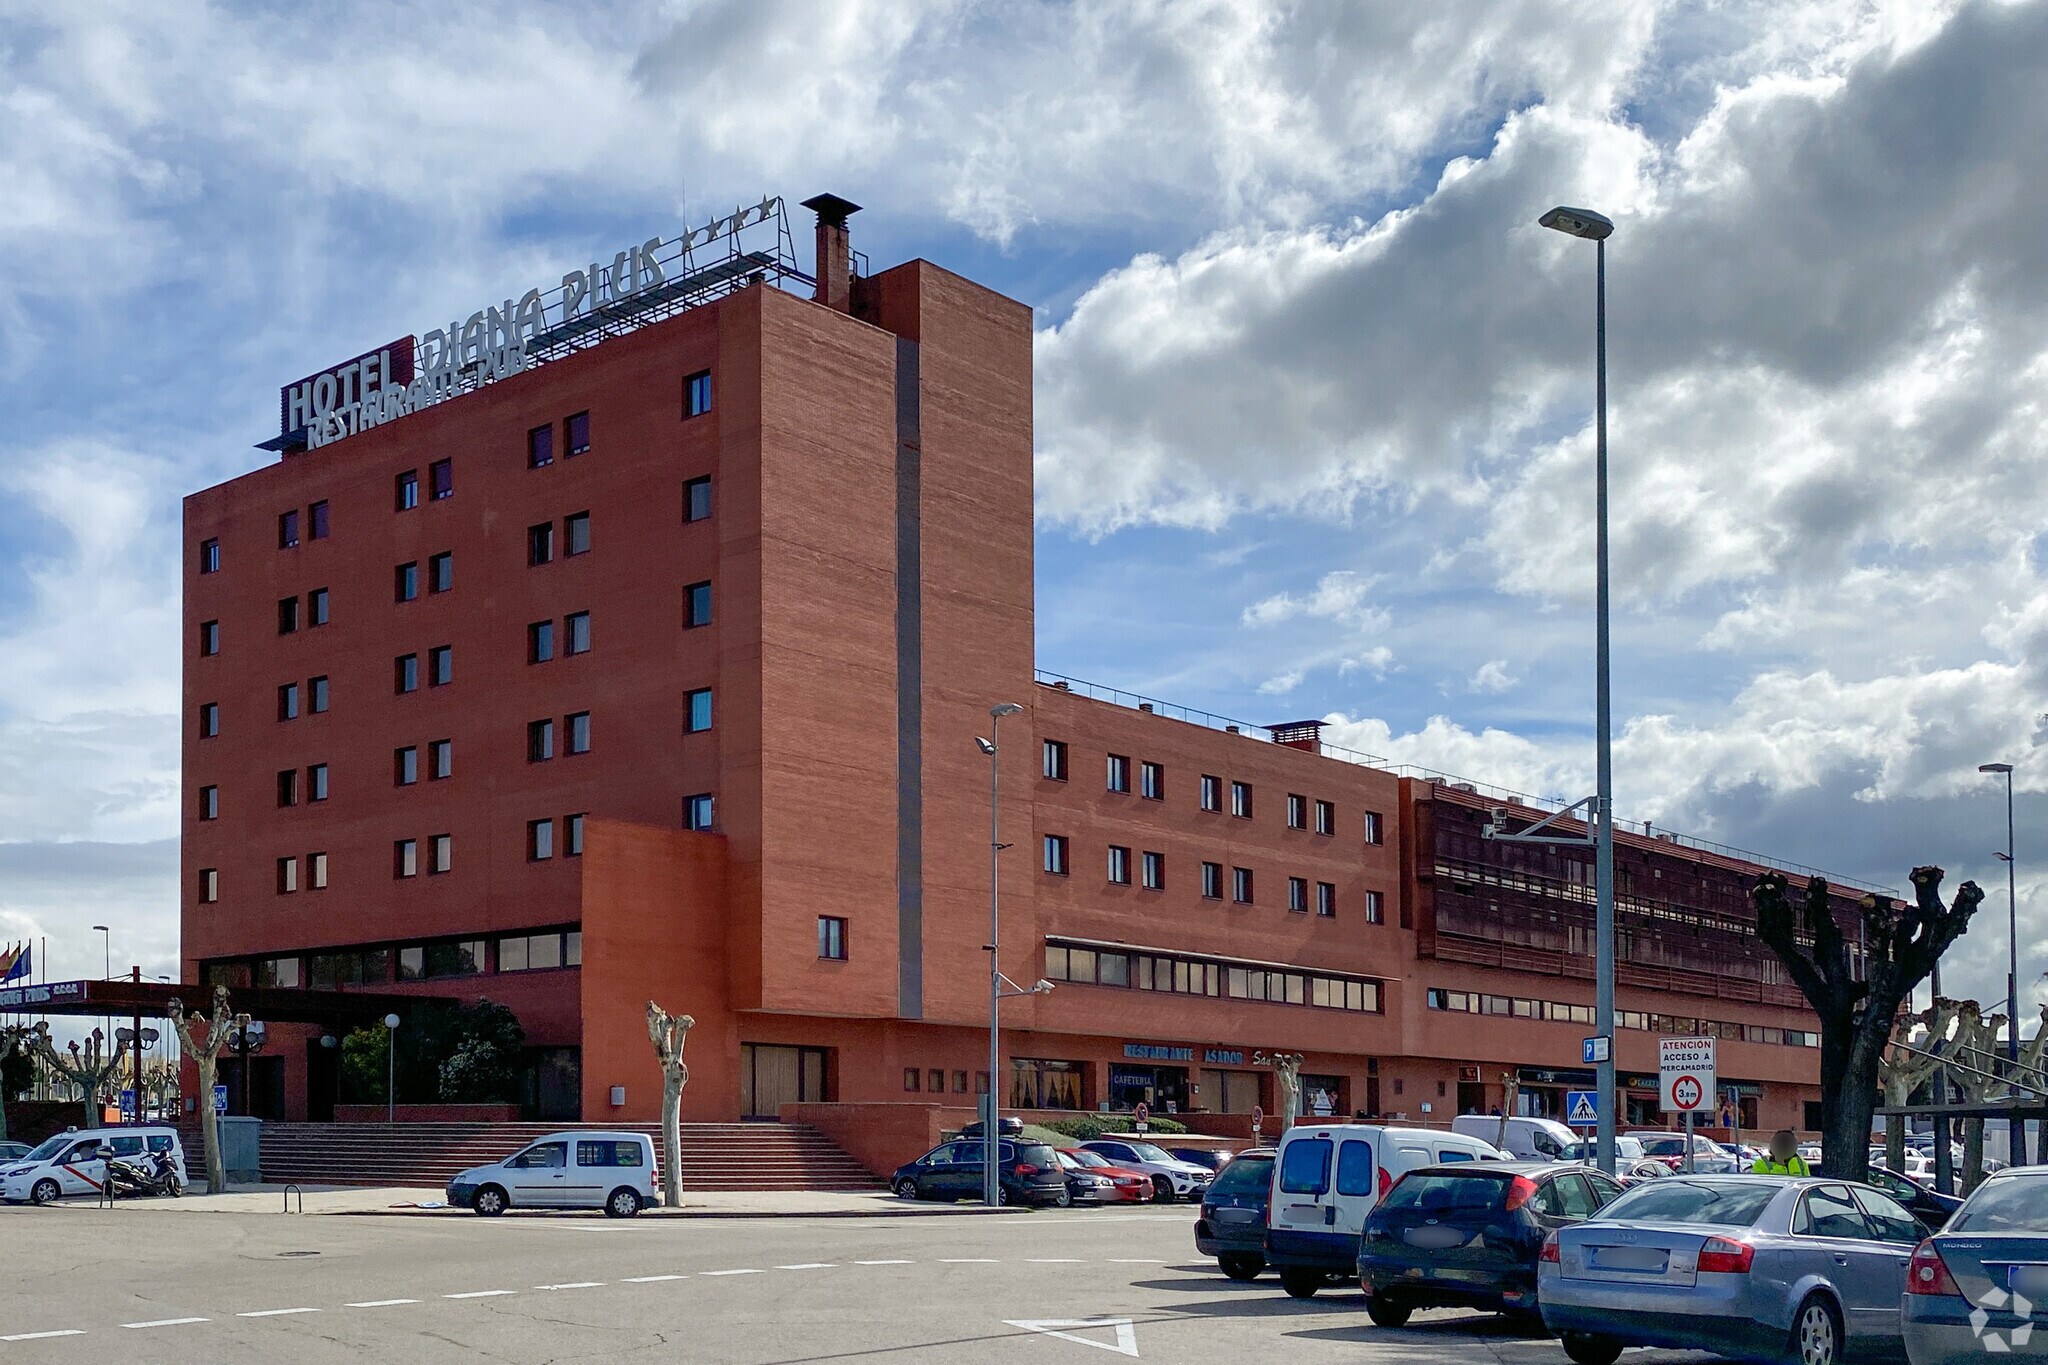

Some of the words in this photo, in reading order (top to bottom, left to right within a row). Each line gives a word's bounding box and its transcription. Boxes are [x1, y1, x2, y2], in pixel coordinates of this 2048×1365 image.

[289, 350, 394, 432] HOTEL
[424, 288, 542, 372] DIANA
[562, 237, 666, 322] PLUS
[1205, 1050, 1244, 1065] ASADOR
[1664, 1053, 1699, 1061] ACCESO
[1661, 1064, 1713, 1072] MERCAMADRID
[1114, 1075, 1152, 1086] CAFETERIA
